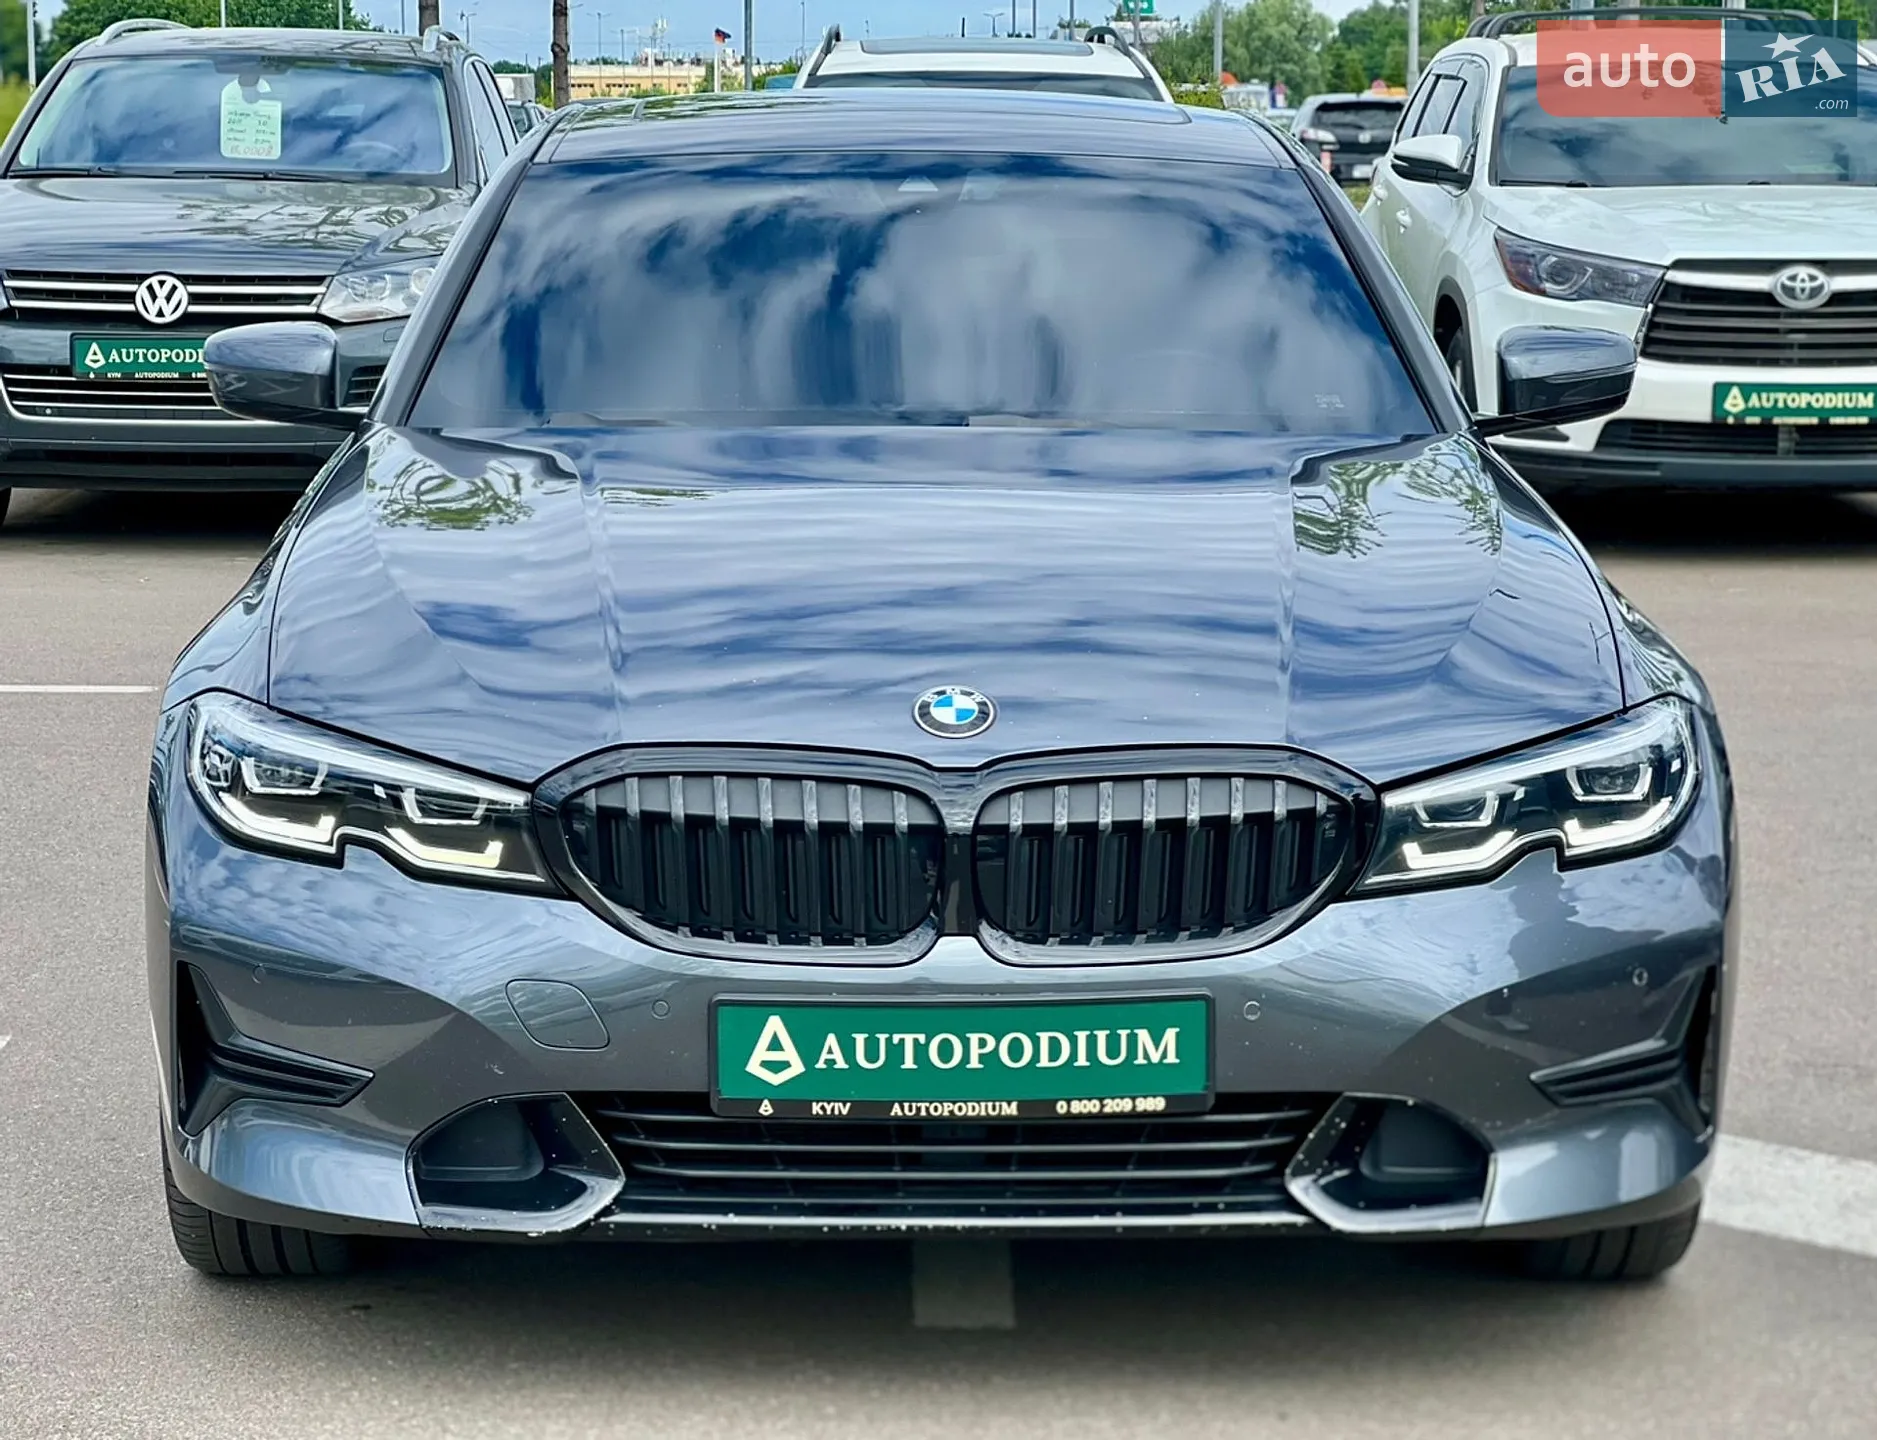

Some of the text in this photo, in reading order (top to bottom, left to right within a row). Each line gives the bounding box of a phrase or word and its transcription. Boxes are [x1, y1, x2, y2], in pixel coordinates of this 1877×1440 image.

[108, 348, 204, 363] AUTOPODI
[1747, 392, 1875, 408] AUTOPODIUM
[814, 1027, 1181, 1070] AUTOPODIUM
[811, 1102, 851, 1116] KYIV
[890, 1101, 1019, 1117] AUTOPODIUM
[1056, 1100, 1068, 1114] 0
[1070, 1098, 1100, 1114] 800
[1103, 1097, 1133, 1113] 209
